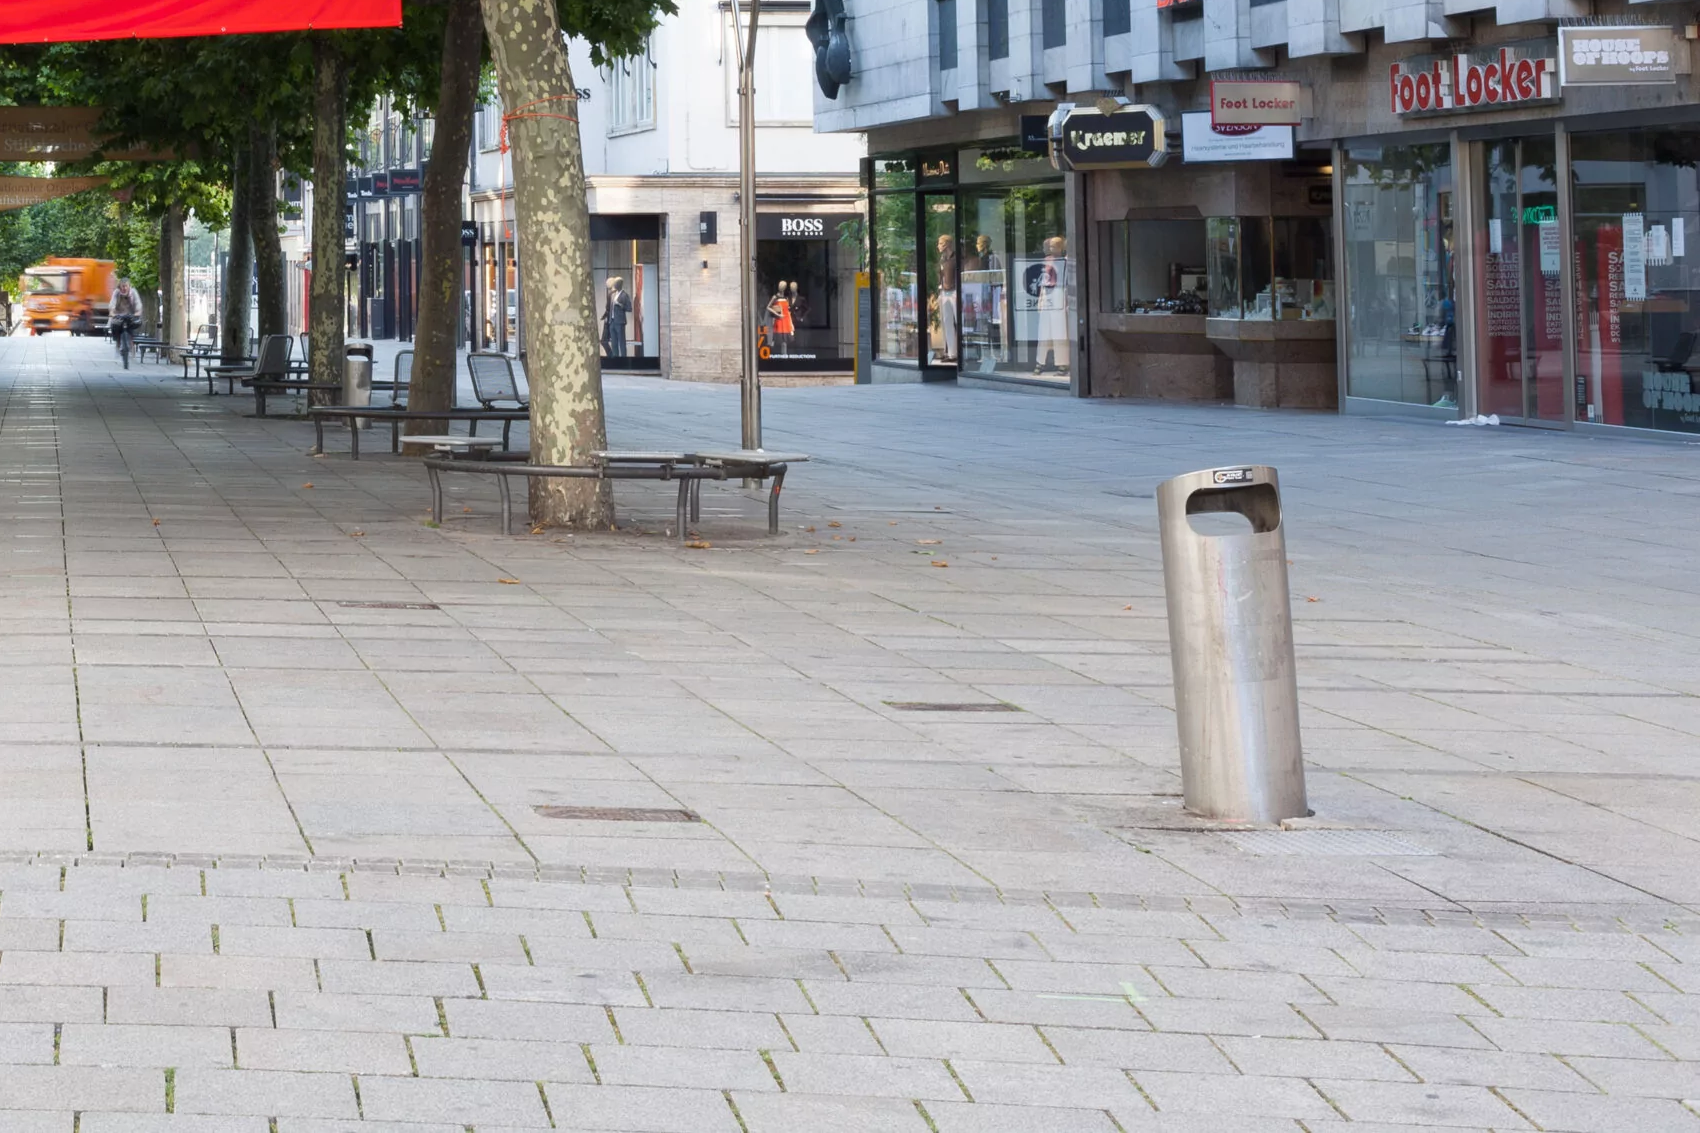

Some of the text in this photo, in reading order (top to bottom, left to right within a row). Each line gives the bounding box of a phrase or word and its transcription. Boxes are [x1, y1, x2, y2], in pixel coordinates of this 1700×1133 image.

[1572, 38, 1640, 53] HOUSE
[1572, 51, 1669, 66] OF HOOPS
[1390, 47, 1550, 114] Foot Locker
[1220, 98, 1296, 109] Foot Locker
[1070, 130, 1146, 151] Kraemer
[781, 218, 823, 232] BOSS
[1662, 391, 1700, 413] HOOP
